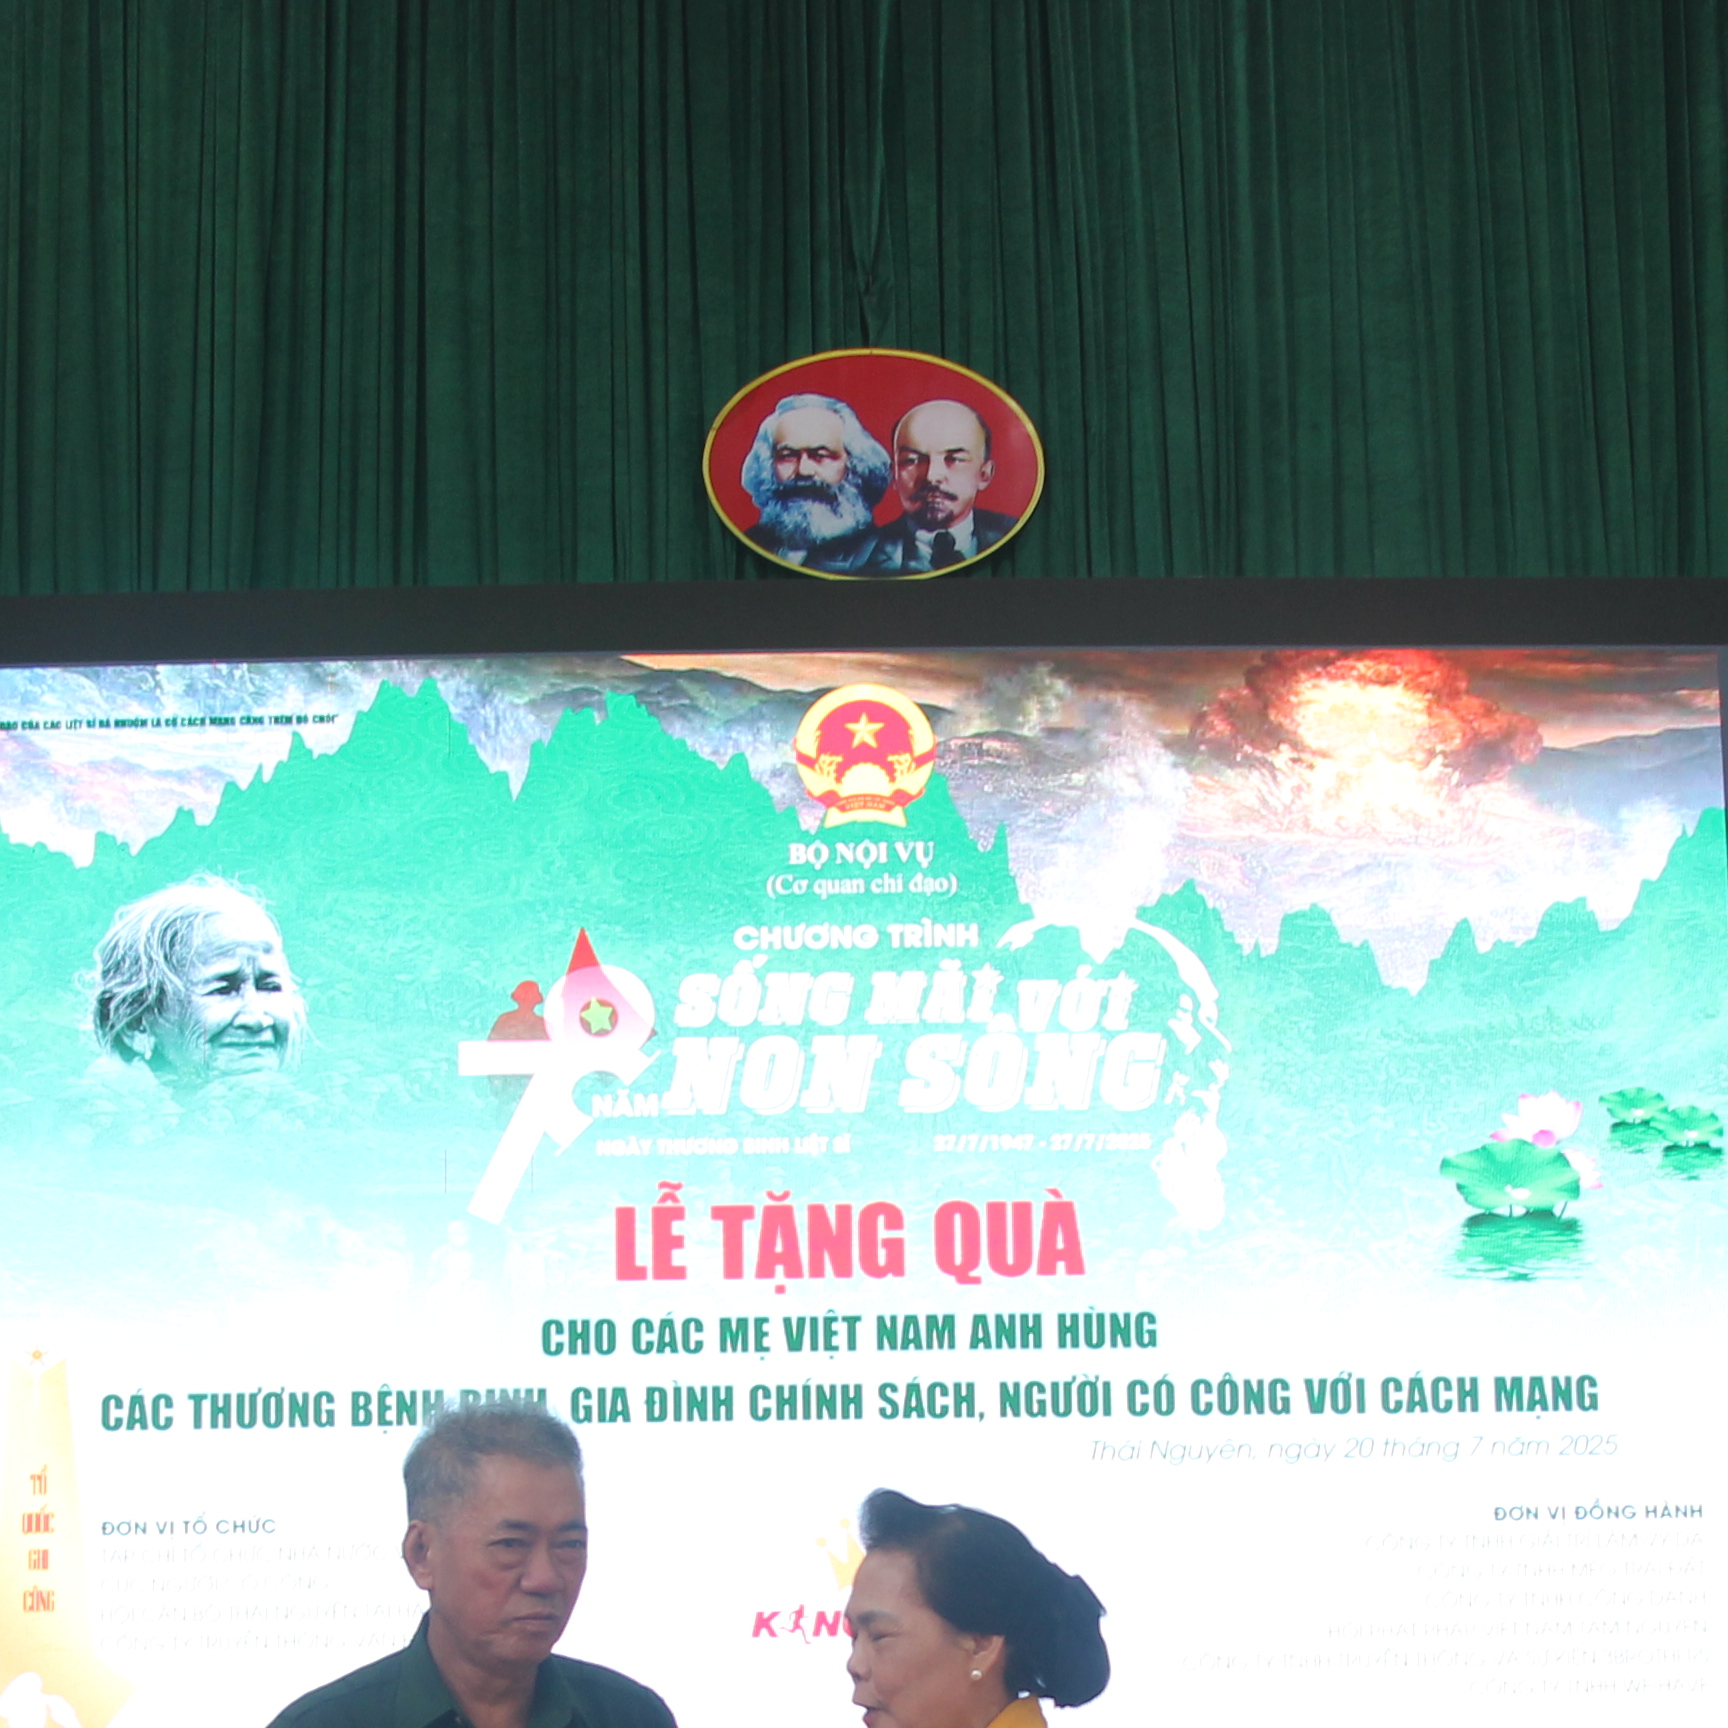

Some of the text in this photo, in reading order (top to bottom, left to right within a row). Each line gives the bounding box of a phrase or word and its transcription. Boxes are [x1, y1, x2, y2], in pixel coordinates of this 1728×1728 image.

[788, 839, 934, 872] BỘ NỘI VỤ
[766, 871, 958, 899] (Cơ quan chỉ đạo)
[733, 918, 978, 951] CHƯƠNG TRÌNH
[673, 954, 1138, 1032] SỐNG MÃI VỚI
[667, 1012, 1167, 1114] NON SÔNG
[592, 1091, 658, 1118] NĂM
[596, 1134, 652, 1156] NGÀY
[656, 1134, 737, 1155] THƯƠNG
[743, 1136, 786, 1154] BINH
[614, 1180, 1086, 1295] LỄ TẶNG QUÀ
[542, 1304, 1158, 1361] CHO CÁC MẸ VIỆT NAM ANH HÙNG
[100, 1387, 173, 1431] CÁC
[188, 1386, 335, 1429] THƯƠNG
[571, 1387, 631, 1425] GIA
[644, 1380, 735, 1423] ĐÌNH
[749, 1378, 862, 1422] CHÍNH
[878, 1376, 985, 1422] SÁCH,
[998, 1372, 1111, 1419] NGƯỜI
[1126, 1372, 1177, 1417] CÓ
[1190, 1372, 1291, 1417] CÔNG
[1304, 1368, 1365, 1416] VỚI
[1381, 1370, 1480, 1415] CÁCH
[1494, 1373, 1599, 1421] MẠNG
[1090, 1433, 1618, 1465] Thái Nguyên, ngày 20 tháng 7 năm 2025
[101, 1510, 276, 1541] ĐƠN VỊ TỔ CHỨC
[1493, 1498, 1704, 1524] ĐƠN VỊ ĐỒNG HÀNH
